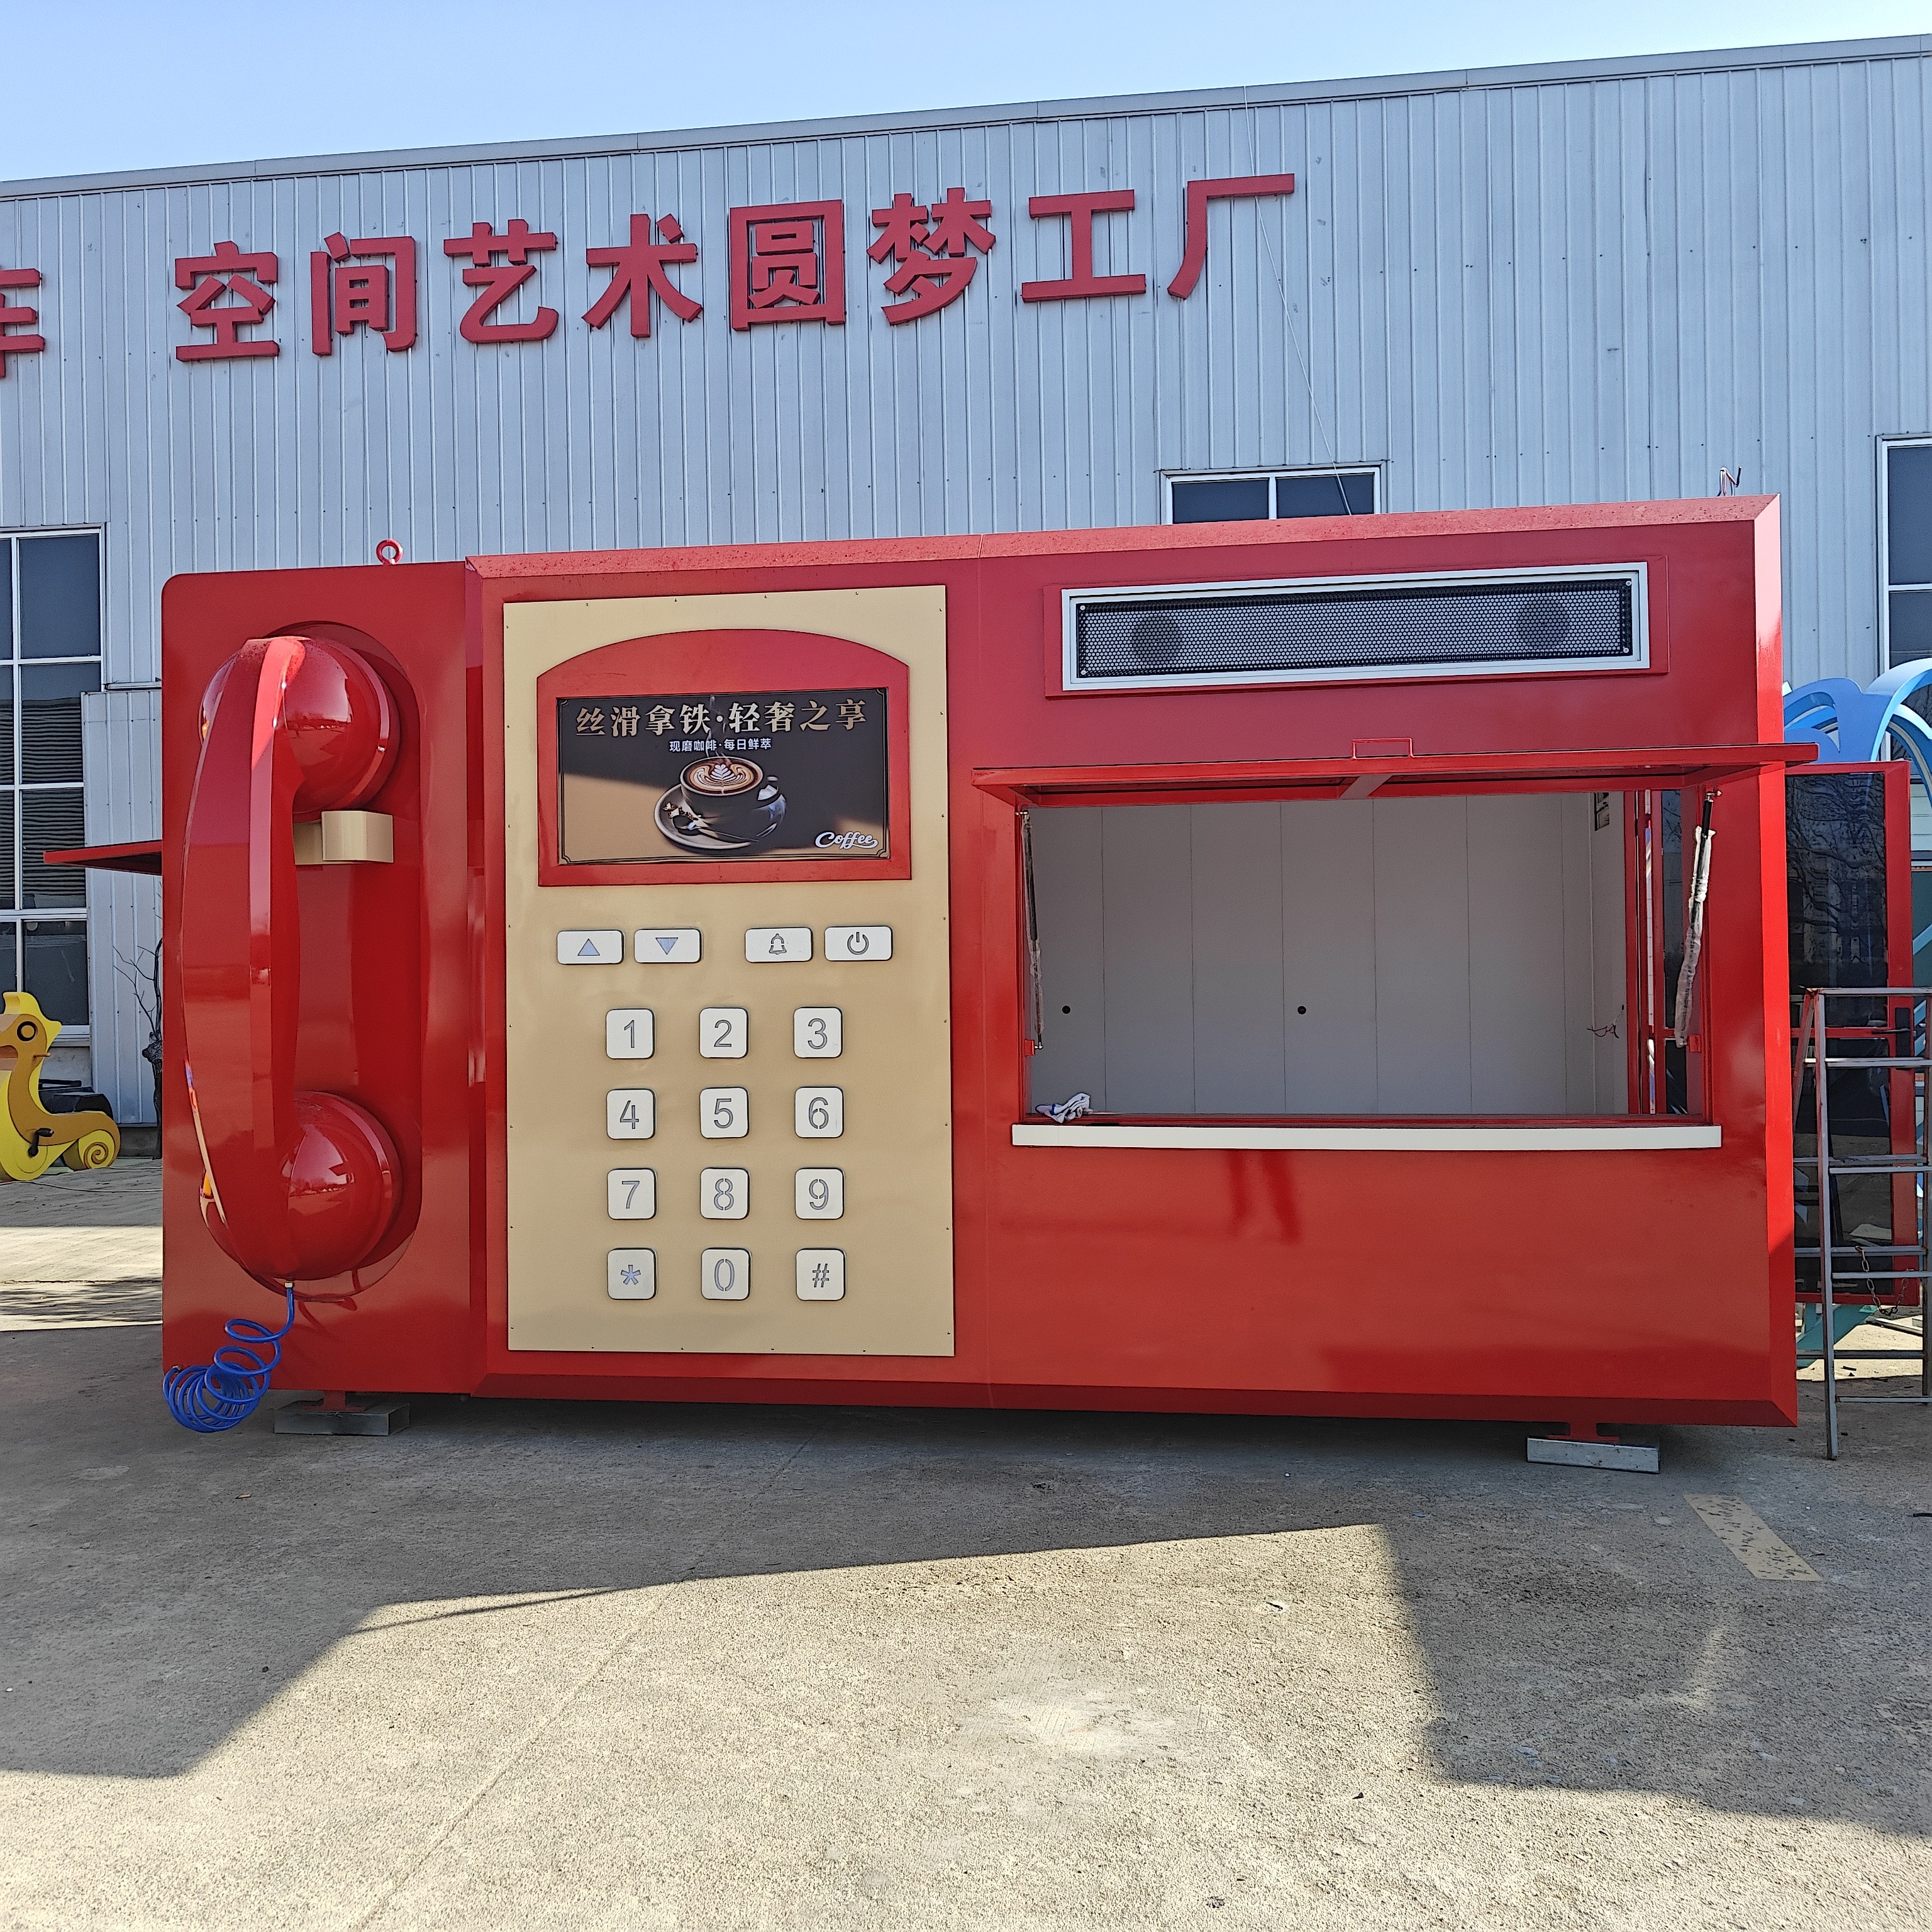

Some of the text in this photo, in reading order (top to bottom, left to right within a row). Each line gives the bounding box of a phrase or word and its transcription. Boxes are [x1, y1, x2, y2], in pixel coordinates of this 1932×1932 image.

[175, 173, 1295, 362] 空间艺术圆梦工厂
[575, 699, 866, 737] 丝滑拿铁·轻奢之享
[669, 738, 772, 752] 现磨咖啡·每日鲜萃
[815, 831, 879, 850] Coffee
[623, 1018, 827, 1050] 1 2 3
[619, 1097, 829, 1130] 4 5 6
[621, 1179, 828, 1211] 7 8 9
[714, 1258, 735, 1292] 0
[812, 1263, 830, 1287] #
